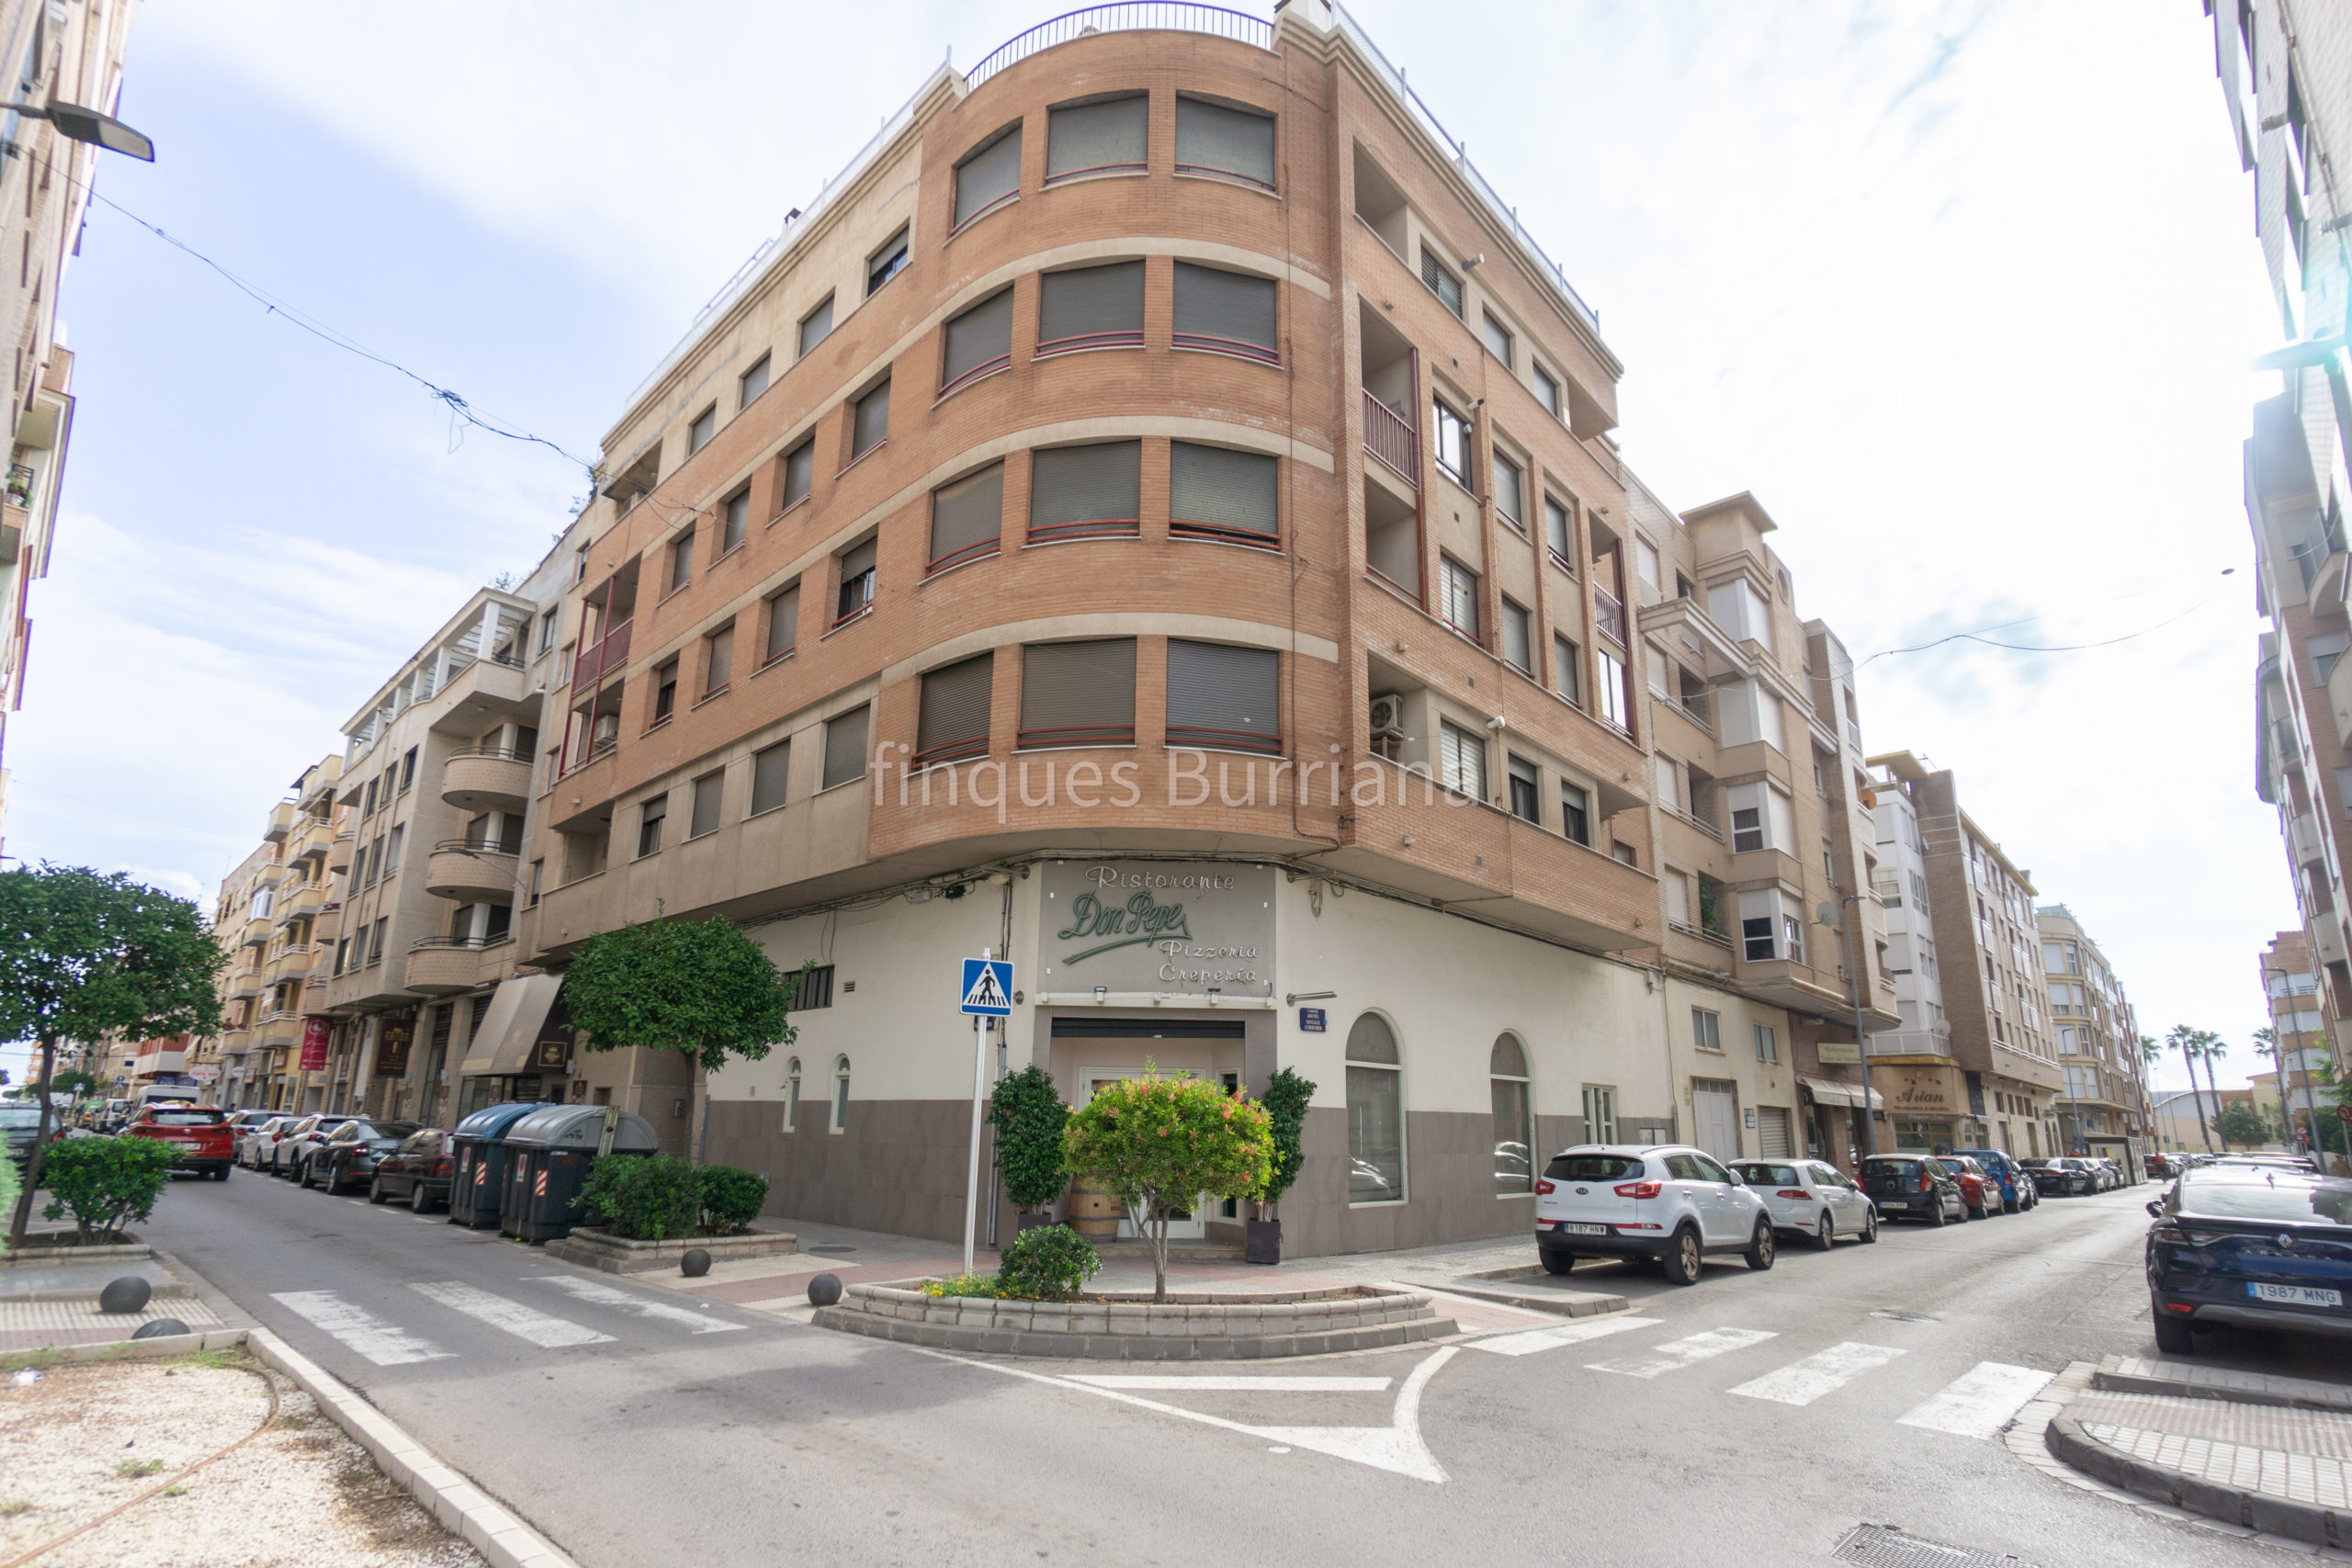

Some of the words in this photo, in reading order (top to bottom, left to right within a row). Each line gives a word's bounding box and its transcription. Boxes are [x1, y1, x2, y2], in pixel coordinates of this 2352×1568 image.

[1085, 866, 1236, 889] Ristorante
[1058, 889, 1125, 940] Don
[1126, 891, 1193, 947] Pepe
[2259, 1285, 2297, 1299] 1987
[2303, 1289, 2336, 1303] MNG
